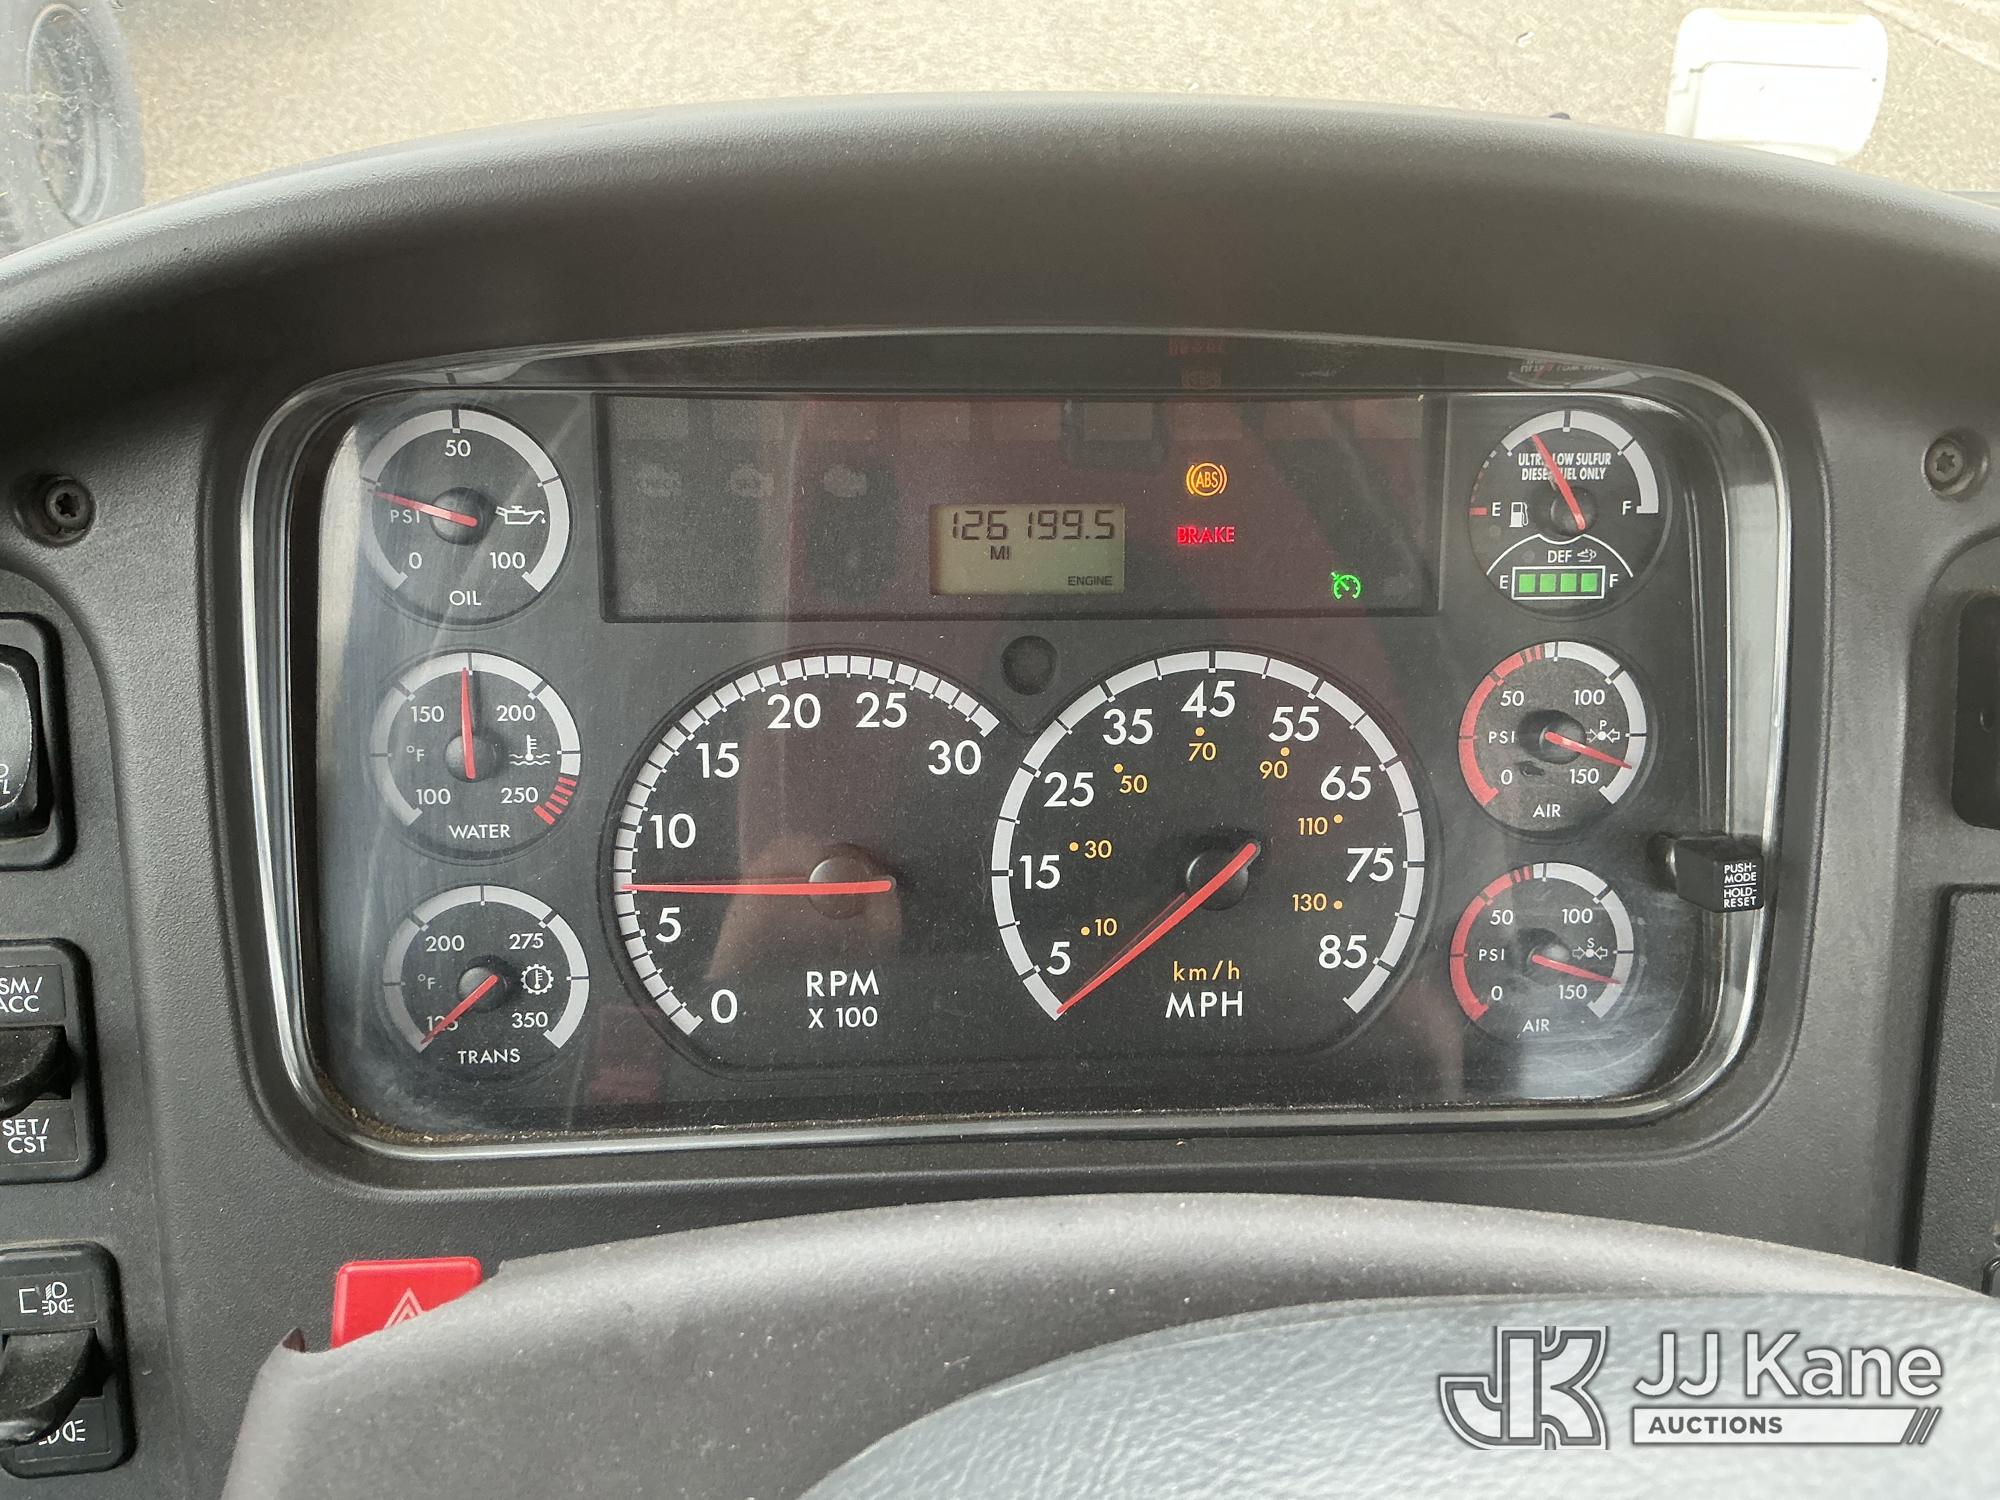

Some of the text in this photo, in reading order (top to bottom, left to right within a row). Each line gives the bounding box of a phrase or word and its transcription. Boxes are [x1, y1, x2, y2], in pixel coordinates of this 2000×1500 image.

[445, 440, 471, 457] 50
[1518, 453, 1548, 466] ULTR
[1576, 453, 1612, 466] SULFUR
[1196, 472, 1219, 488] ABS
[1522, 467, 1553, 480] DIESE
[1579, 467, 1606, 480] ONLY
[1492, 502, 1501, 516] E
[1622, 501, 1632, 515] F
[390, 510, 421, 524] PSI
[1177, 527, 1235, 544] BRAKE
[409, 552, 422, 569] 0
[490, 552, 526, 569] 100
[990, 546, 1010, 560] MI
[1547, 550, 1572, 563] DEF
[1068, 576, 1113, 586] ENGINE
[1500, 575, 1508, 589] E
[1609, 574, 1619, 588] F
[449, 591, 481, 606] OIL
[1181, 681, 1235, 718] 45
[1500, 690, 1524, 706] 50
[1573, 689, 1605, 705] 100
[411, 706, 444, 722] 150
[496, 705, 535, 721] 200
[767, 693, 821, 729] 20
[856, 692, 908, 728] 25
[1103, 709, 1153, 745] 35
[1268, 706, 1319, 742] 55
[1488, 731, 1515, 743] PSI
[928, 740, 982, 775] 30
[1188, 742, 1216, 761] 70
[696, 742, 740, 778] 15
[1259, 761, 1288, 780] 90
[1501, 769, 1512, 785] 0
[1569, 768, 1600, 784] 150
[1044, 772, 1094, 808] 25
[1119, 775, 1148, 794] 50
[1320, 765, 1371, 801] 65
[416, 789, 450, 805] 100
[500, 787, 538, 804] 250
[1532, 804, 1560, 817] AIR
[449, 825, 511, 839] WATER
[649, 813, 696, 849] 10
[1298, 817, 1328, 836] 110
[1084, 840, 1112, 859] 30
[1019, 855, 1060, 890] 15
[1346, 848, 1394, 883] 75
[1724, 862, 1757, 874] PUSH-
[1724, 872, 1757, 883] MODE
[1724, 887, 1757, 898] HOLD-
[1292, 893, 1327, 912] 130
[1724, 896, 1757, 908] RESET
[1490, 910, 1513, 925] 50
[1562, 908, 1593, 924] 100
[656, 907, 681, 942] 5
[1094, 918, 1118, 937] 10
[425, 935, 465, 952] 200
[509, 933, 544, 949] 275
[1047, 941, 1071, 976] 5
[1318, 935, 1367, 969] 85
[1479, 948, 1505, 961] PSI
[1173, 960, 1240, 981] km/h
[806, 969, 879, 996] RPM
[1491, 985, 1503, 1001] 0
[1558, 984, 1587, 1000] 150
[711, 989, 737, 1023] 0
[1165, 991, 1243, 1019] MPH
[511, 1012, 548, 1028] 350
[808, 1006, 878, 1028] X 100
[1522, 1019, 1550, 1033] AIR
[458, 1049, 521, 1064] TRANS
[2, 1118, 50, 1136] SET/
[7, 1136, 48, 1153] CST
